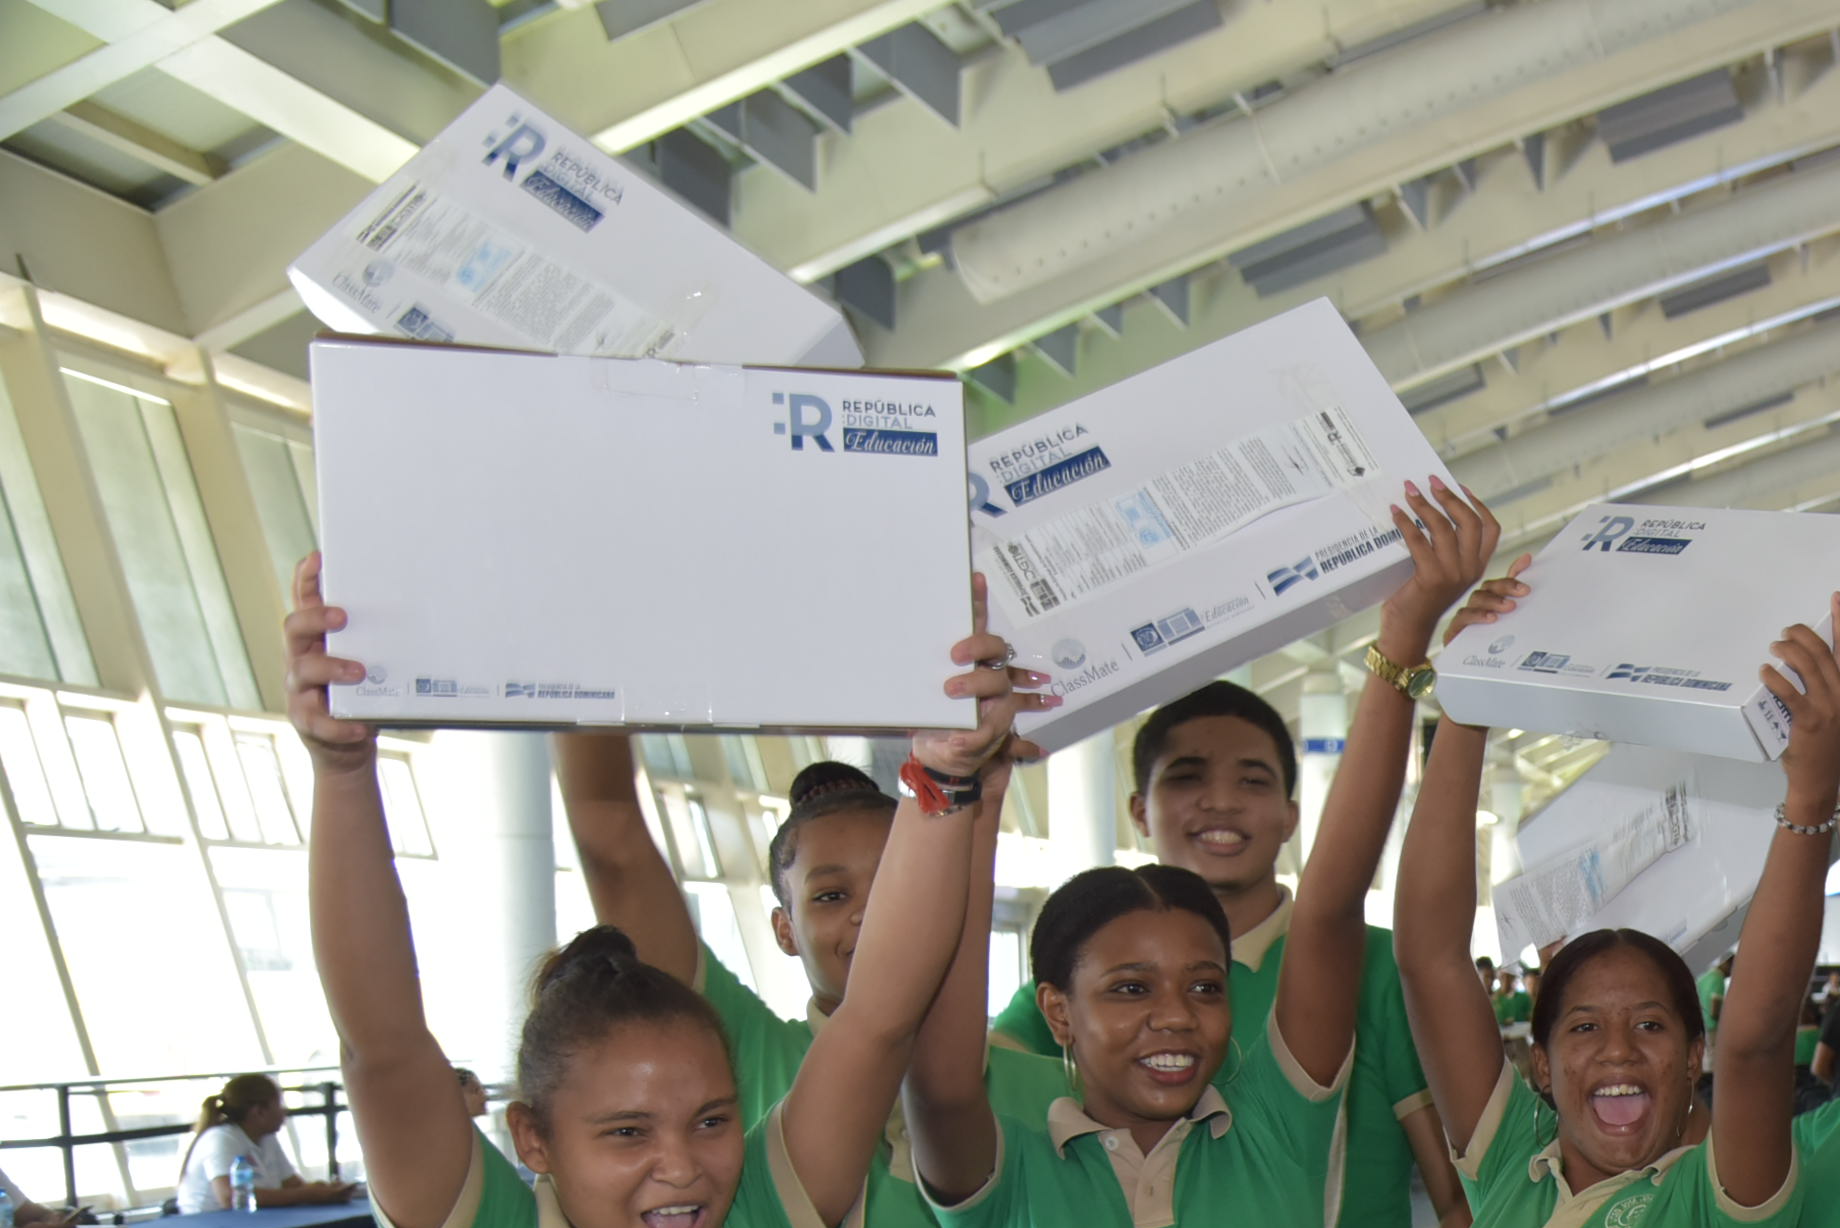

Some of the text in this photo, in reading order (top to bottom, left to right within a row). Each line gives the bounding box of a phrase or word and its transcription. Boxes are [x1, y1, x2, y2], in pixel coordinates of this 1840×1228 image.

[843, 400, 936, 417] REPÚBLICA
[845, 431, 936, 455] Educación
[989, 424, 1089, 472] REPÚBLICA
[1010, 450, 1105, 503] Educación
[1641, 519, 1706, 530] REPÚBLICA
[1314, 533, 1359, 561] PRESIDENCIA
[1319, 540, 1375, 575] REPÚBLICA
[1050, 660, 1120, 698] ClassMate
